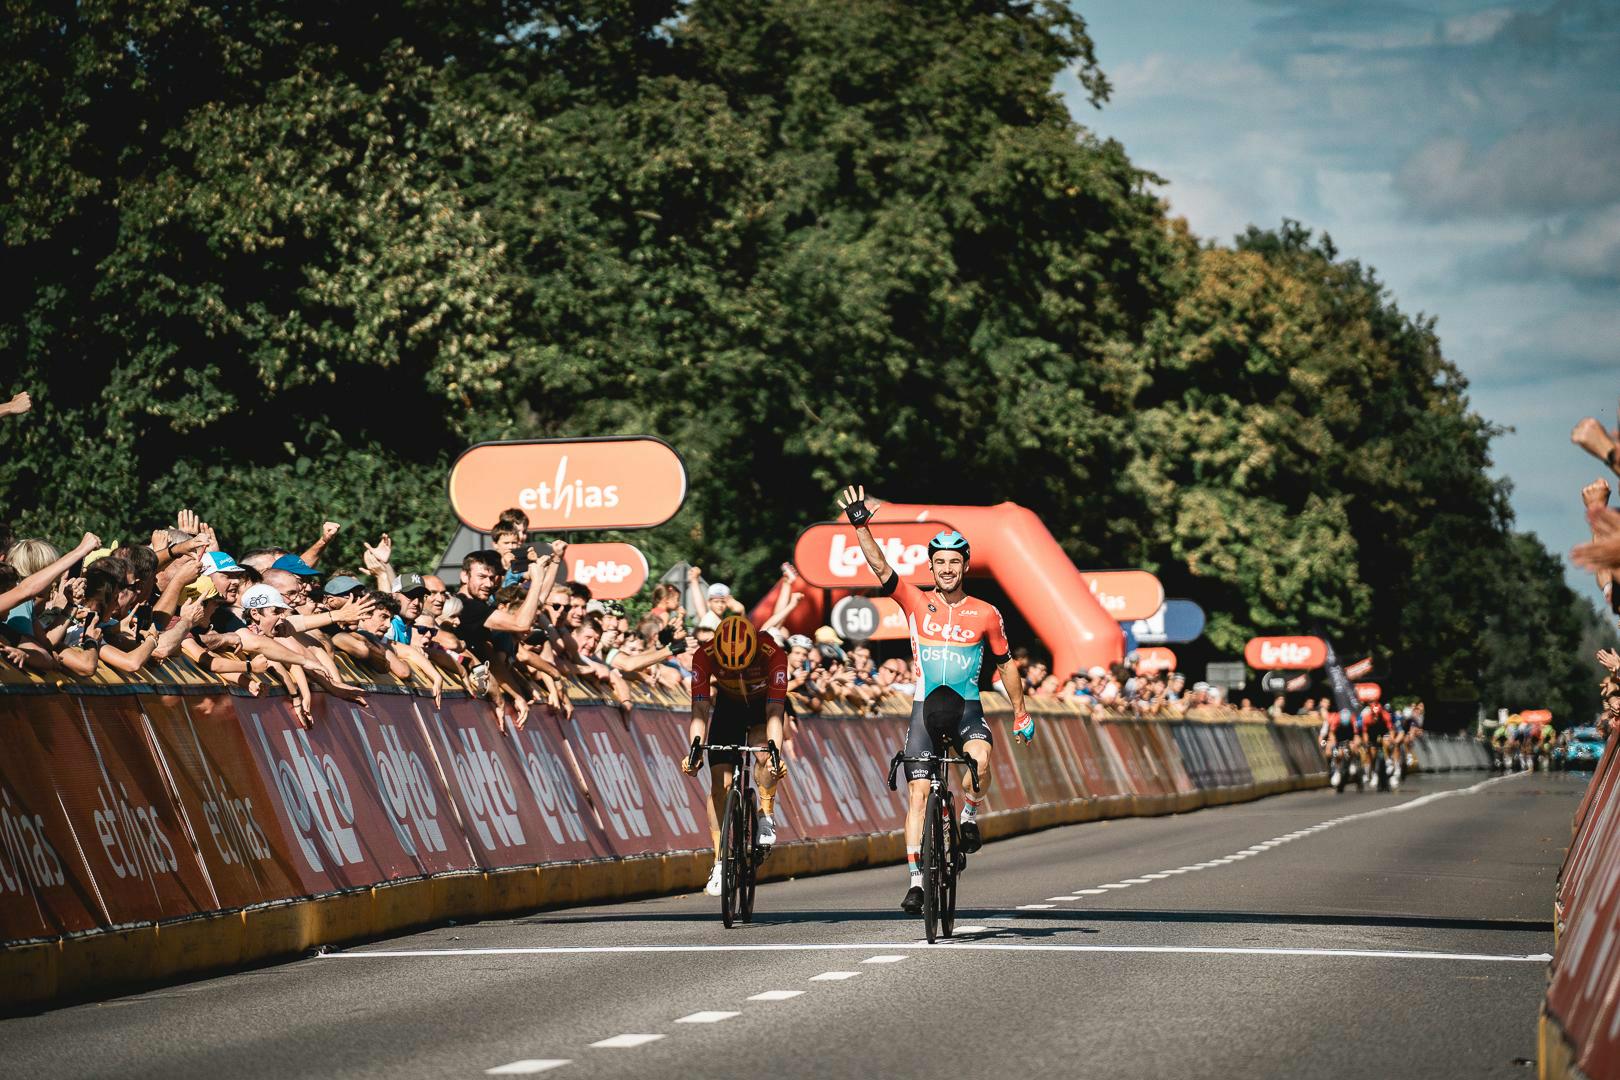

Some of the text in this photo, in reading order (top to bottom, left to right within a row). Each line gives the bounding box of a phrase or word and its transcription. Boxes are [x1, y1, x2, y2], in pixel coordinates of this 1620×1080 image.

[519, 456, 619, 518] ethias
[574, 560, 632, 584] lotto
[846, 607, 873, 632] 50
[922, 612, 975, 642] lotto
[922, 647, 971, 670] dstny
[79, 697, 177, 912] ethias
[181, 697, 271, 896] ethias
[251, 713, 363, 872] lotto
[351, 708, 447, 856] lotto
[434, 713, 527, 851] lotto
[505, 715, 587, 844] lotto
[571, 719, 651, 840] lotto
